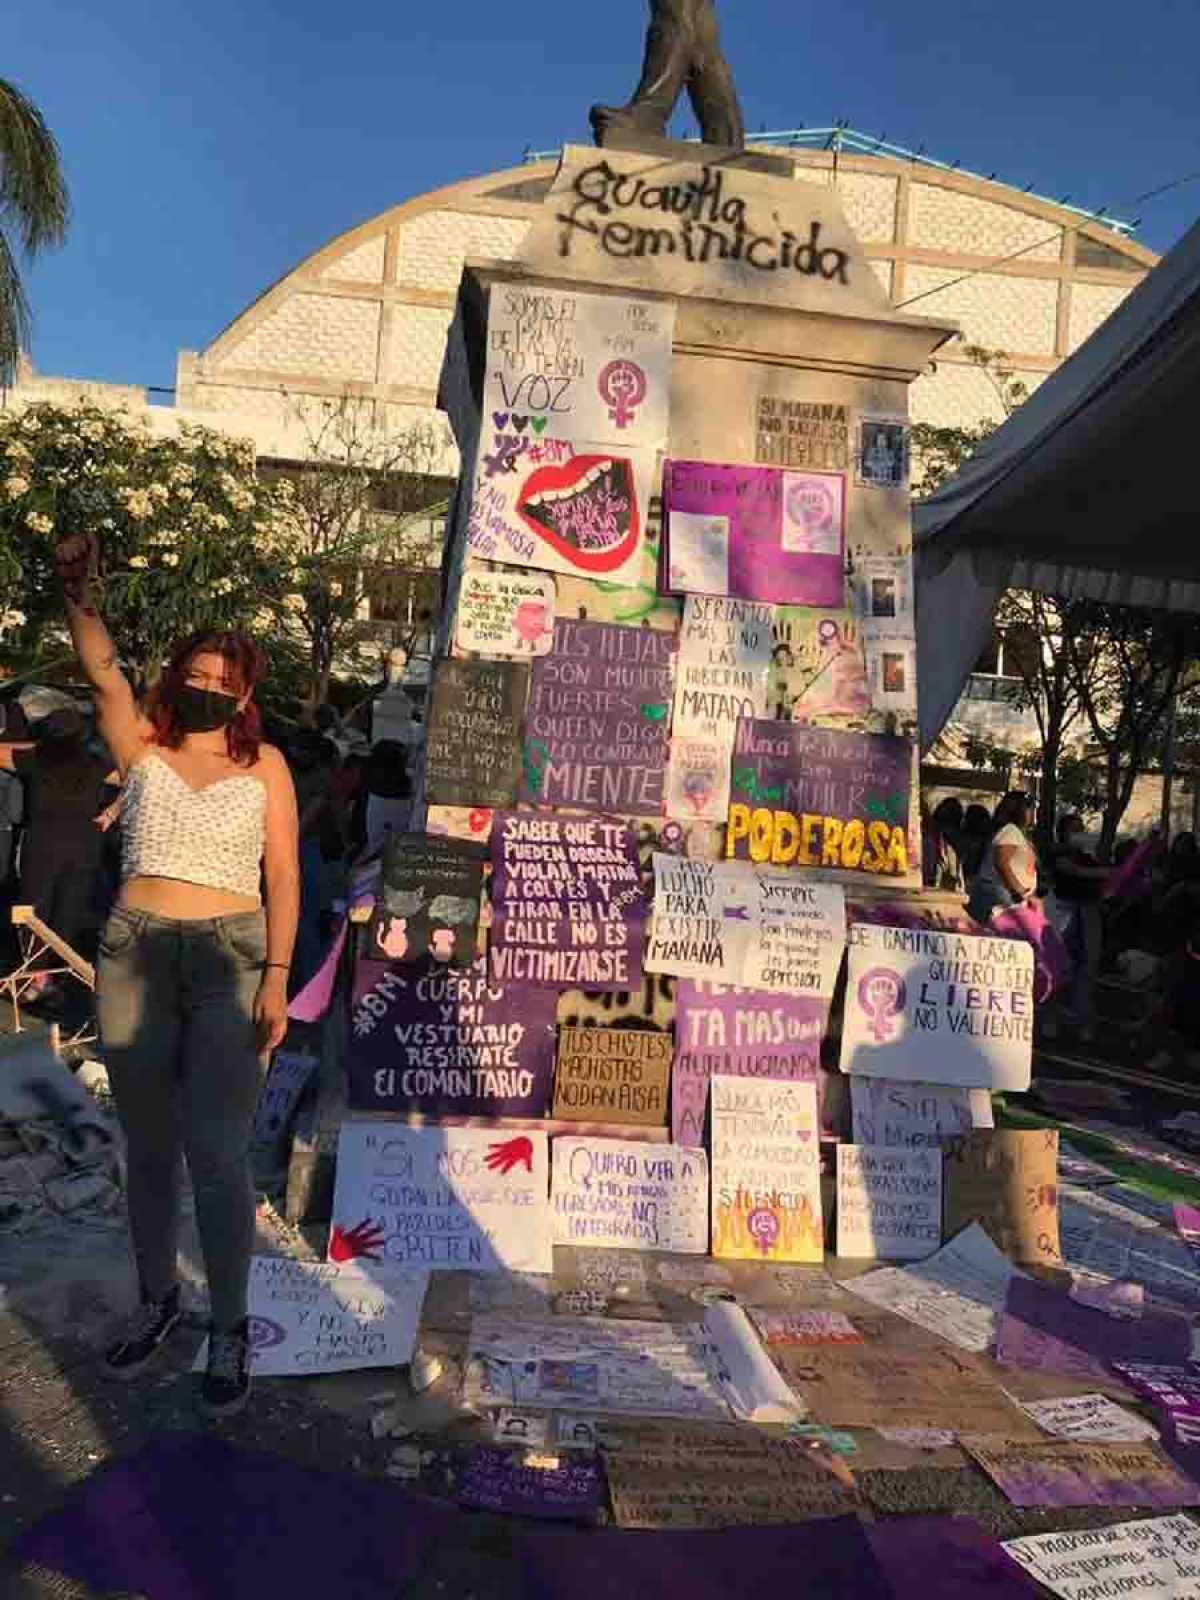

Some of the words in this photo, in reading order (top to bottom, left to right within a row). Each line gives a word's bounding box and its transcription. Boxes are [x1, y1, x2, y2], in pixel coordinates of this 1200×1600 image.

[493, 372, 572, 413] VOZ
[543, 660, 589, 685] SON
[542, 761, 661, 806] MIENTE
[501, 817, 562, 842] SABER
[600, 823, 628, 849] TE
[726, 802, 908, 876] PODEROSA
[503, 841, 567, 861] PUEDEN
[505, 880, 517, 898] A
[523, 881, 588, 899] GOLPES
[597, 881, 612, 902] Y
[503, 900, 562, 920] TIRAR
[568, 901, 593, 920] EN
[597, 902, 624, 922] LA
[665, 893, 709, 917] PARA
[504, 920, 556, 944] CALLE
[572, 922, 598, 945] NO
[605, 923, 628, 946] ES
[882, 931, 948, 958] CAMINO
[490, 946, 629, 983] VICTIMIZARSE
[928, 958, 996, 985] QUIERO
[919, 982, 1026, 1015] LIBRE
[457, 1003, 484, 1024] MI
[914, 1007, 939, 1032] NO
[948, 1010, 1034, 1042] VALIENTE
[394, 1023, 526, 1046] VESTUARIO
[685, 1008, 726, 1047] TA
[631, 1201, 660, 1224] NO
